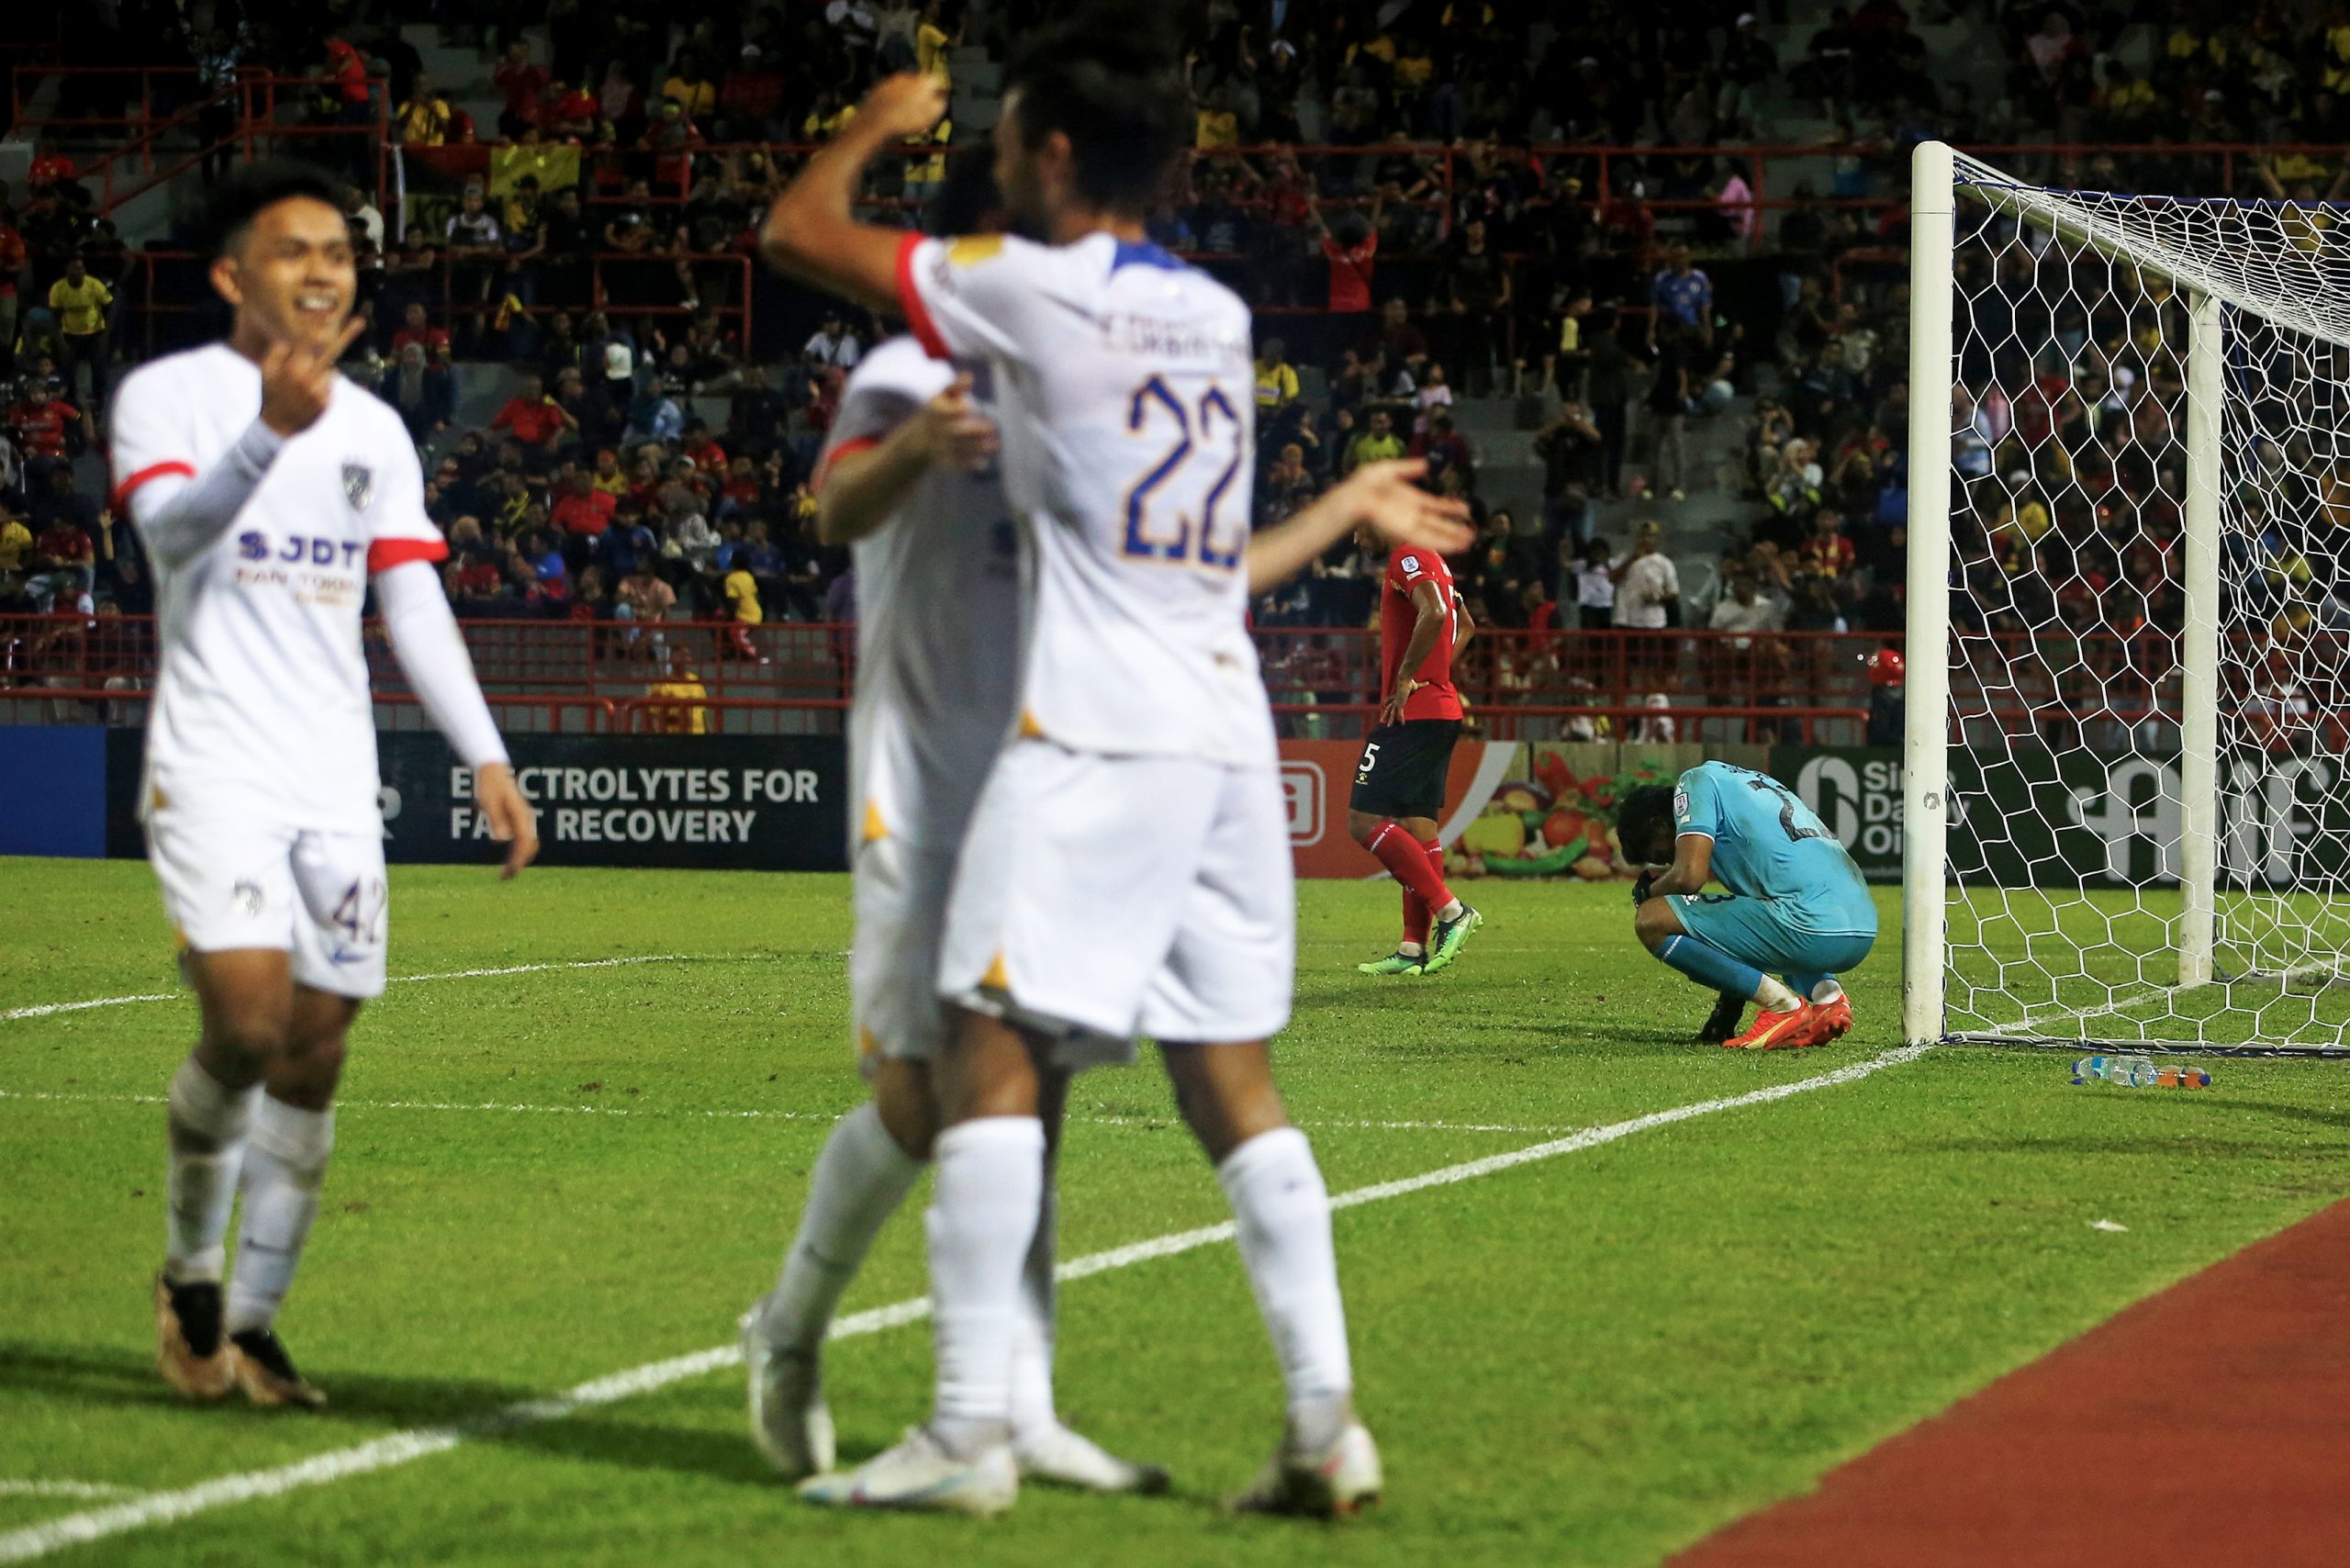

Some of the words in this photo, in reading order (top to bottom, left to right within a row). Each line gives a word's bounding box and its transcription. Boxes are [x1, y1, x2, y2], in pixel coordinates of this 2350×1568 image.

[1121, 373, 1247, 570] 22
[1359, 743, 1381, 772] 5
[452, 767, 731, 801] ECTROLYTES
[742, 769, 819, 802] FOR
[452, 807, 543, 839] FAT
[556, 809, 756, 842] RECOVERY
[2067, 757, 2331, 882] Aif
